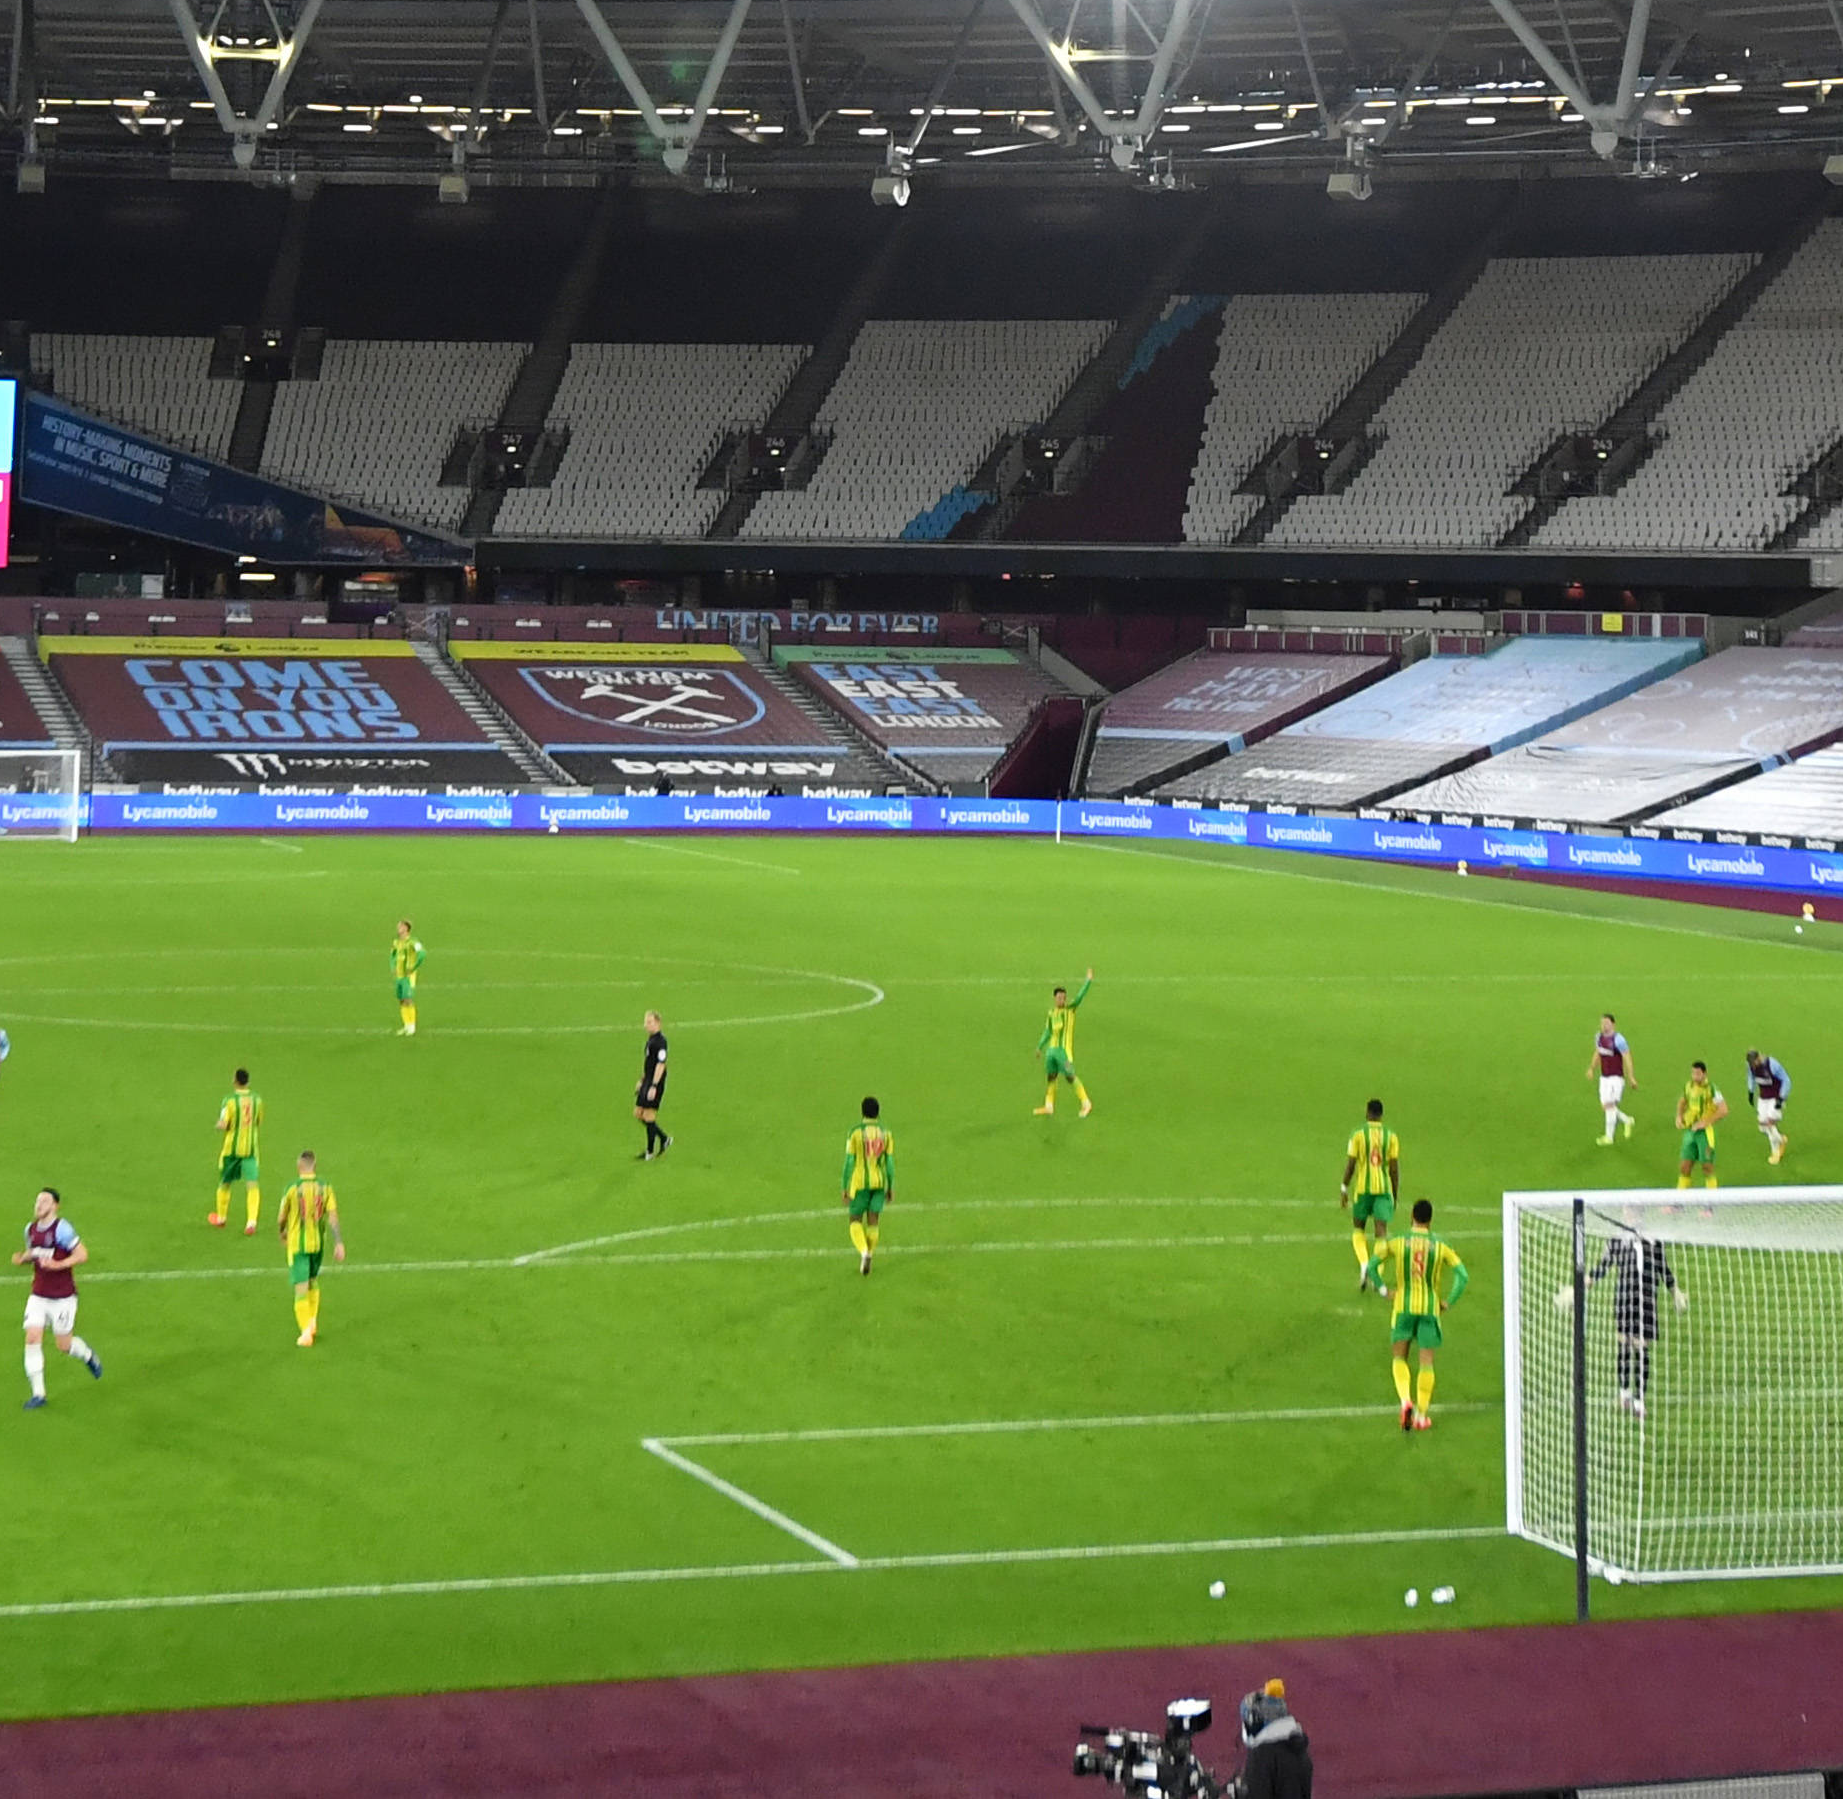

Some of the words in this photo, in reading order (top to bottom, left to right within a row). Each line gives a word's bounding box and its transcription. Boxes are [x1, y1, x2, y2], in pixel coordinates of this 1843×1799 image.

[502, 434, 523, 445] 247
[766, 437, 786, 447] 246
[1040, 439, 1060, 449] 245
[657, 610, 782, 646] UNITED
[123, 659, 382, 688] COME
[809, 663, 943, 681] EAST
[827, 680, 967, 699] EAST
[143, 686, 246, 711] ON
[253, 687, 399, 712] YOU
[848, 698, 987, 716] EAST
[157, 710, 421, 739] IRONS
[644, 719, 719, 729] LONDON
[869, 714, 1005, 728] LONDON
[611, 757, 836, 778] betway
[163, 783, 240, 796] betway
[259, 783, 335, 796] betway
[802, 786, 872, 799] betway
[123, 805, 218, 822] Lycamobile
[276, 804, 369, 822] Lycamobile
[540, 805, 629, 821] Lycamobile
[684, 805, 772, 821] Lycamobile
[1080, 810, 1153, 831] Lycamobile
[1266, 823, 1334, 844] Lycamobile
[1374, 831, 1442, 852] Lycamobile
[1569, 845, 1642, 867] Lycamobile
[1688, 853, 1765, 877] Lycamobile
